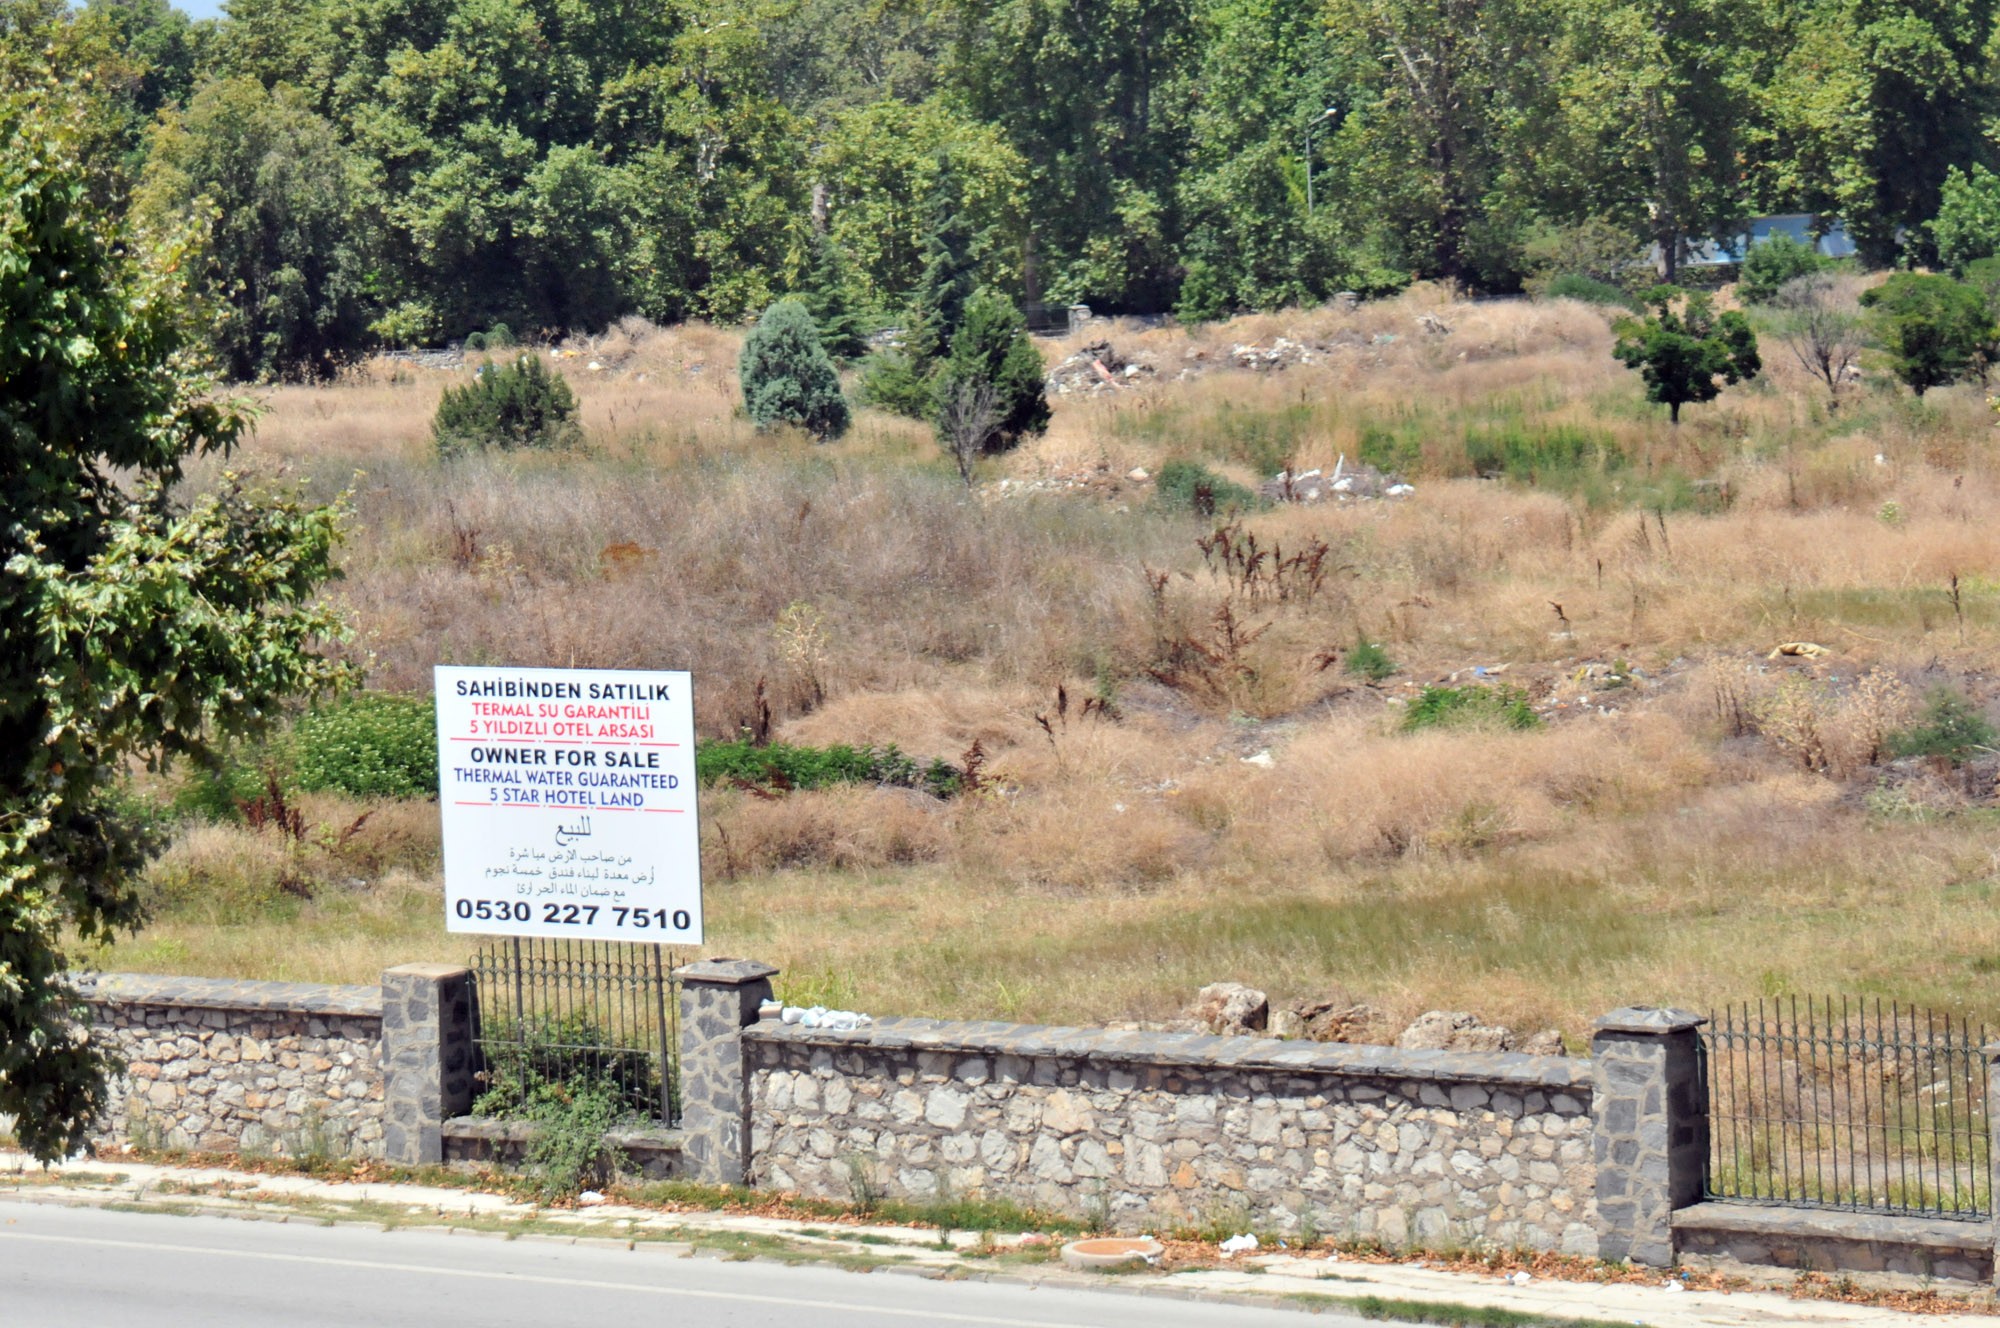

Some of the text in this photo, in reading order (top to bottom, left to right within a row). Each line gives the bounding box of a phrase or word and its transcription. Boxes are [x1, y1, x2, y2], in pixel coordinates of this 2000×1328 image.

[456, 676, 671, 701] SAHİBİNDEN SATILIK
[471, 702, 650, 720] TERMAL SU GARANTİLİ
[469, 720, 654, 738] 5 YILDIZLI OTEL ARSASI
[470, 747, 660, 769] OWNER FOR SALE
[454, 767, 679, 789] THERMAL WATER GUARANTEED
[490, 788, 644, 807] 5 STAR HOTEL LAND
[555, 815, 592, 847] للبيع
[455, 898, 691, 931] 0530 227 7510
